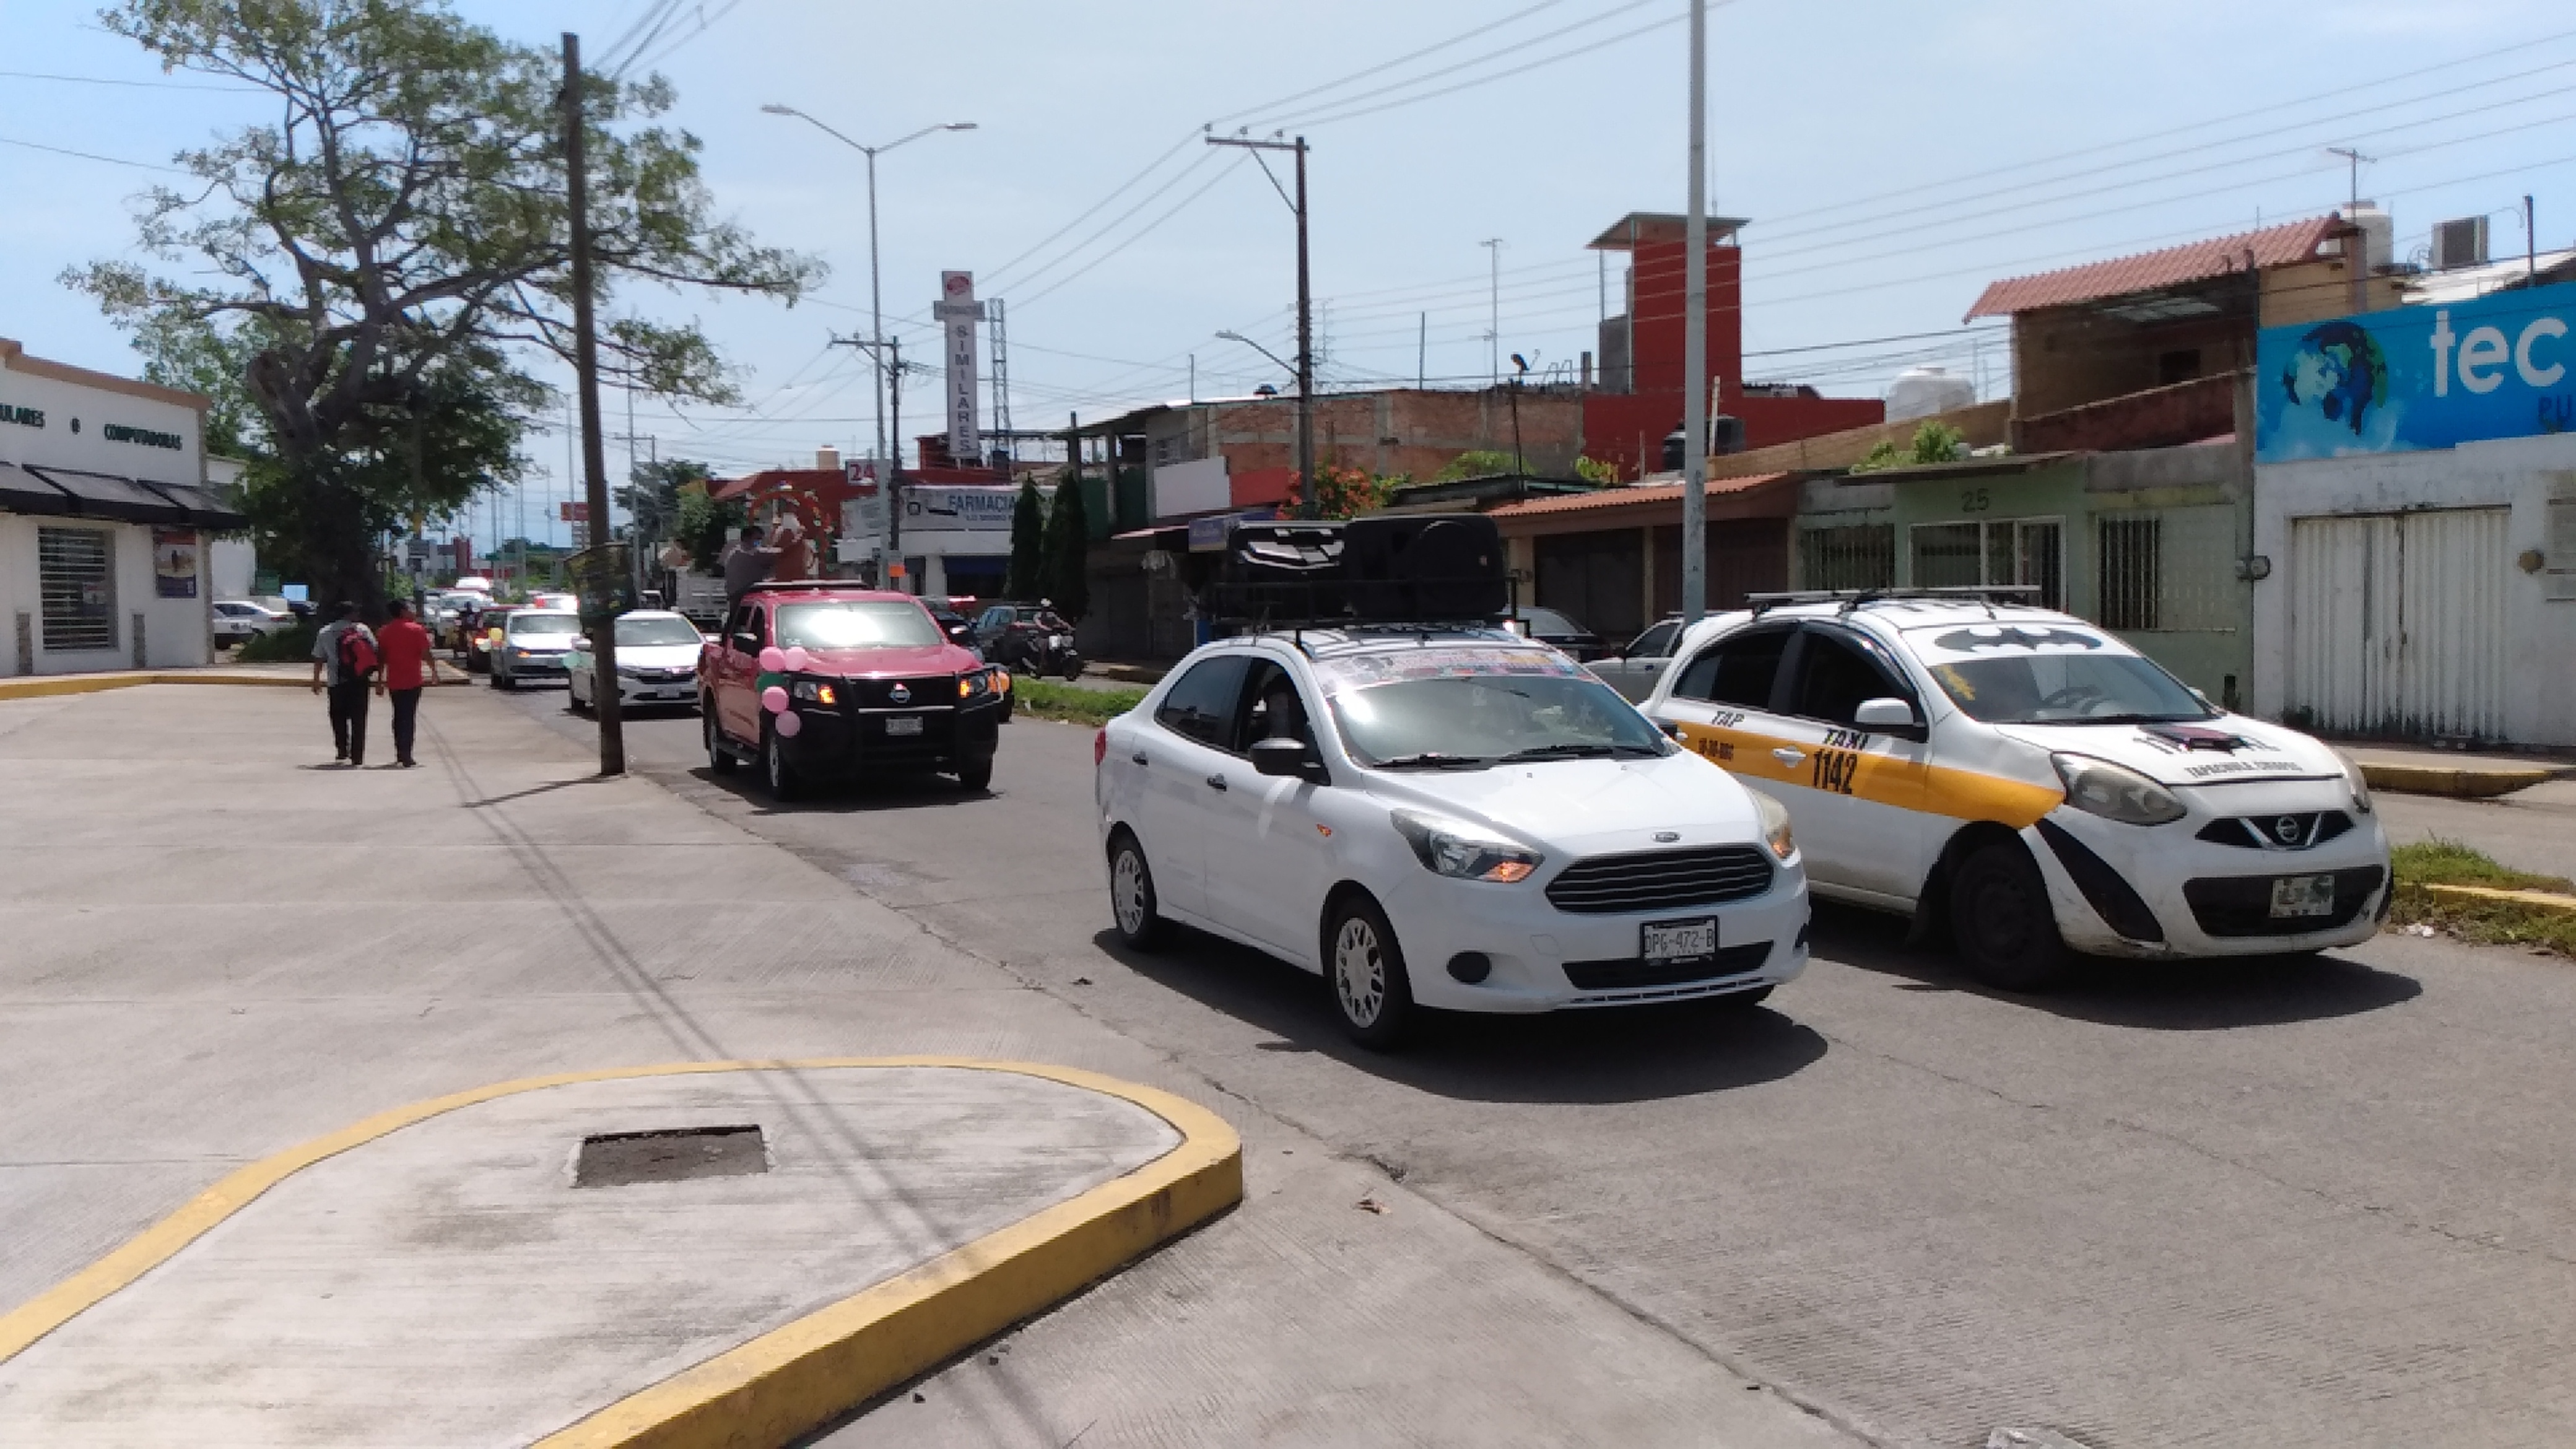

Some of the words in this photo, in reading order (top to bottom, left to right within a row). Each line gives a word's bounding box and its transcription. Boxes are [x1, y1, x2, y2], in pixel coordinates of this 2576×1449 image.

[2430, 311, 2569, 398] tec
[104, 424, 182, 451] COMPUTADORAS
[1961, 488, 1989, 513] 25
[1711, 710, 1746, 728] TAP
[1822, 728, 1869, 751] TAXI
[1812, 748, 1858, 794] 1142
